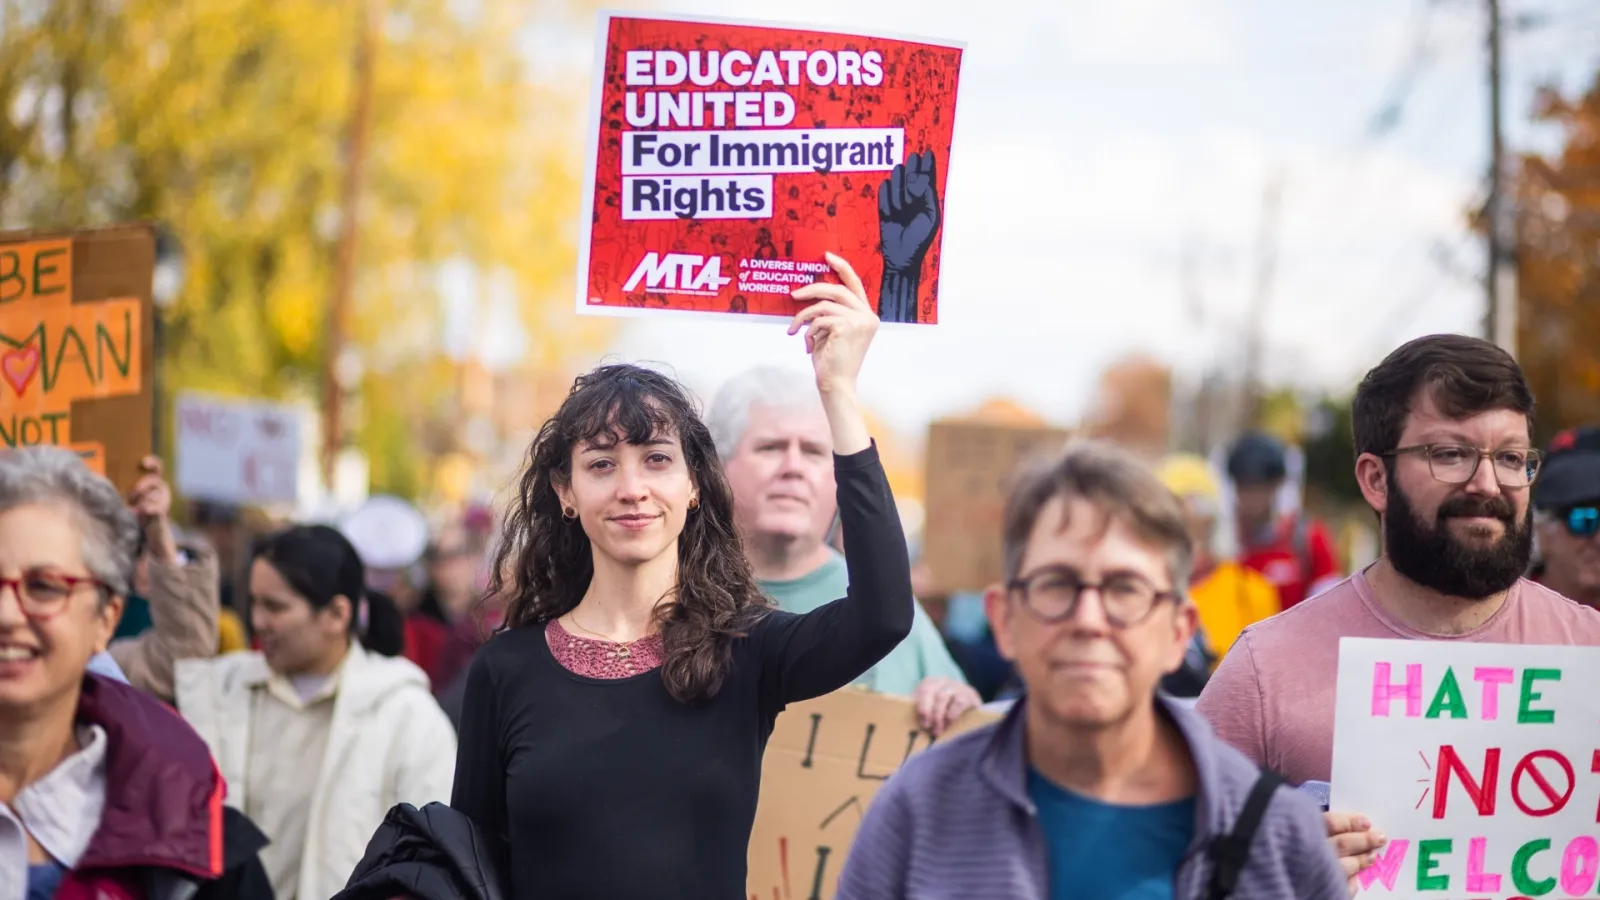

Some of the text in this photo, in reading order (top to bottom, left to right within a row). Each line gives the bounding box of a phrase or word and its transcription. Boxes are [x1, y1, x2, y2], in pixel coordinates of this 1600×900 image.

[625, 50, 883, 86] EDUCATORS
[624, 91, 796, 127] UNITED
[632, 134, 894, 174] For Immigrant
[631, 179, 766, 219] Rights
[622, 252, 731, 291] MTA
[739, 271, 814, 284] of EDUCATION
[740, 260, 748, 268] A
[750, 260, 795, 271] DIVERSE
[738, 282, 790, 294] WORKERS
[1371, 662, 1561, 723] HATE
[1432, 745, 1600, 823] NO
[1356, 836, 1600, 897] WELCO
